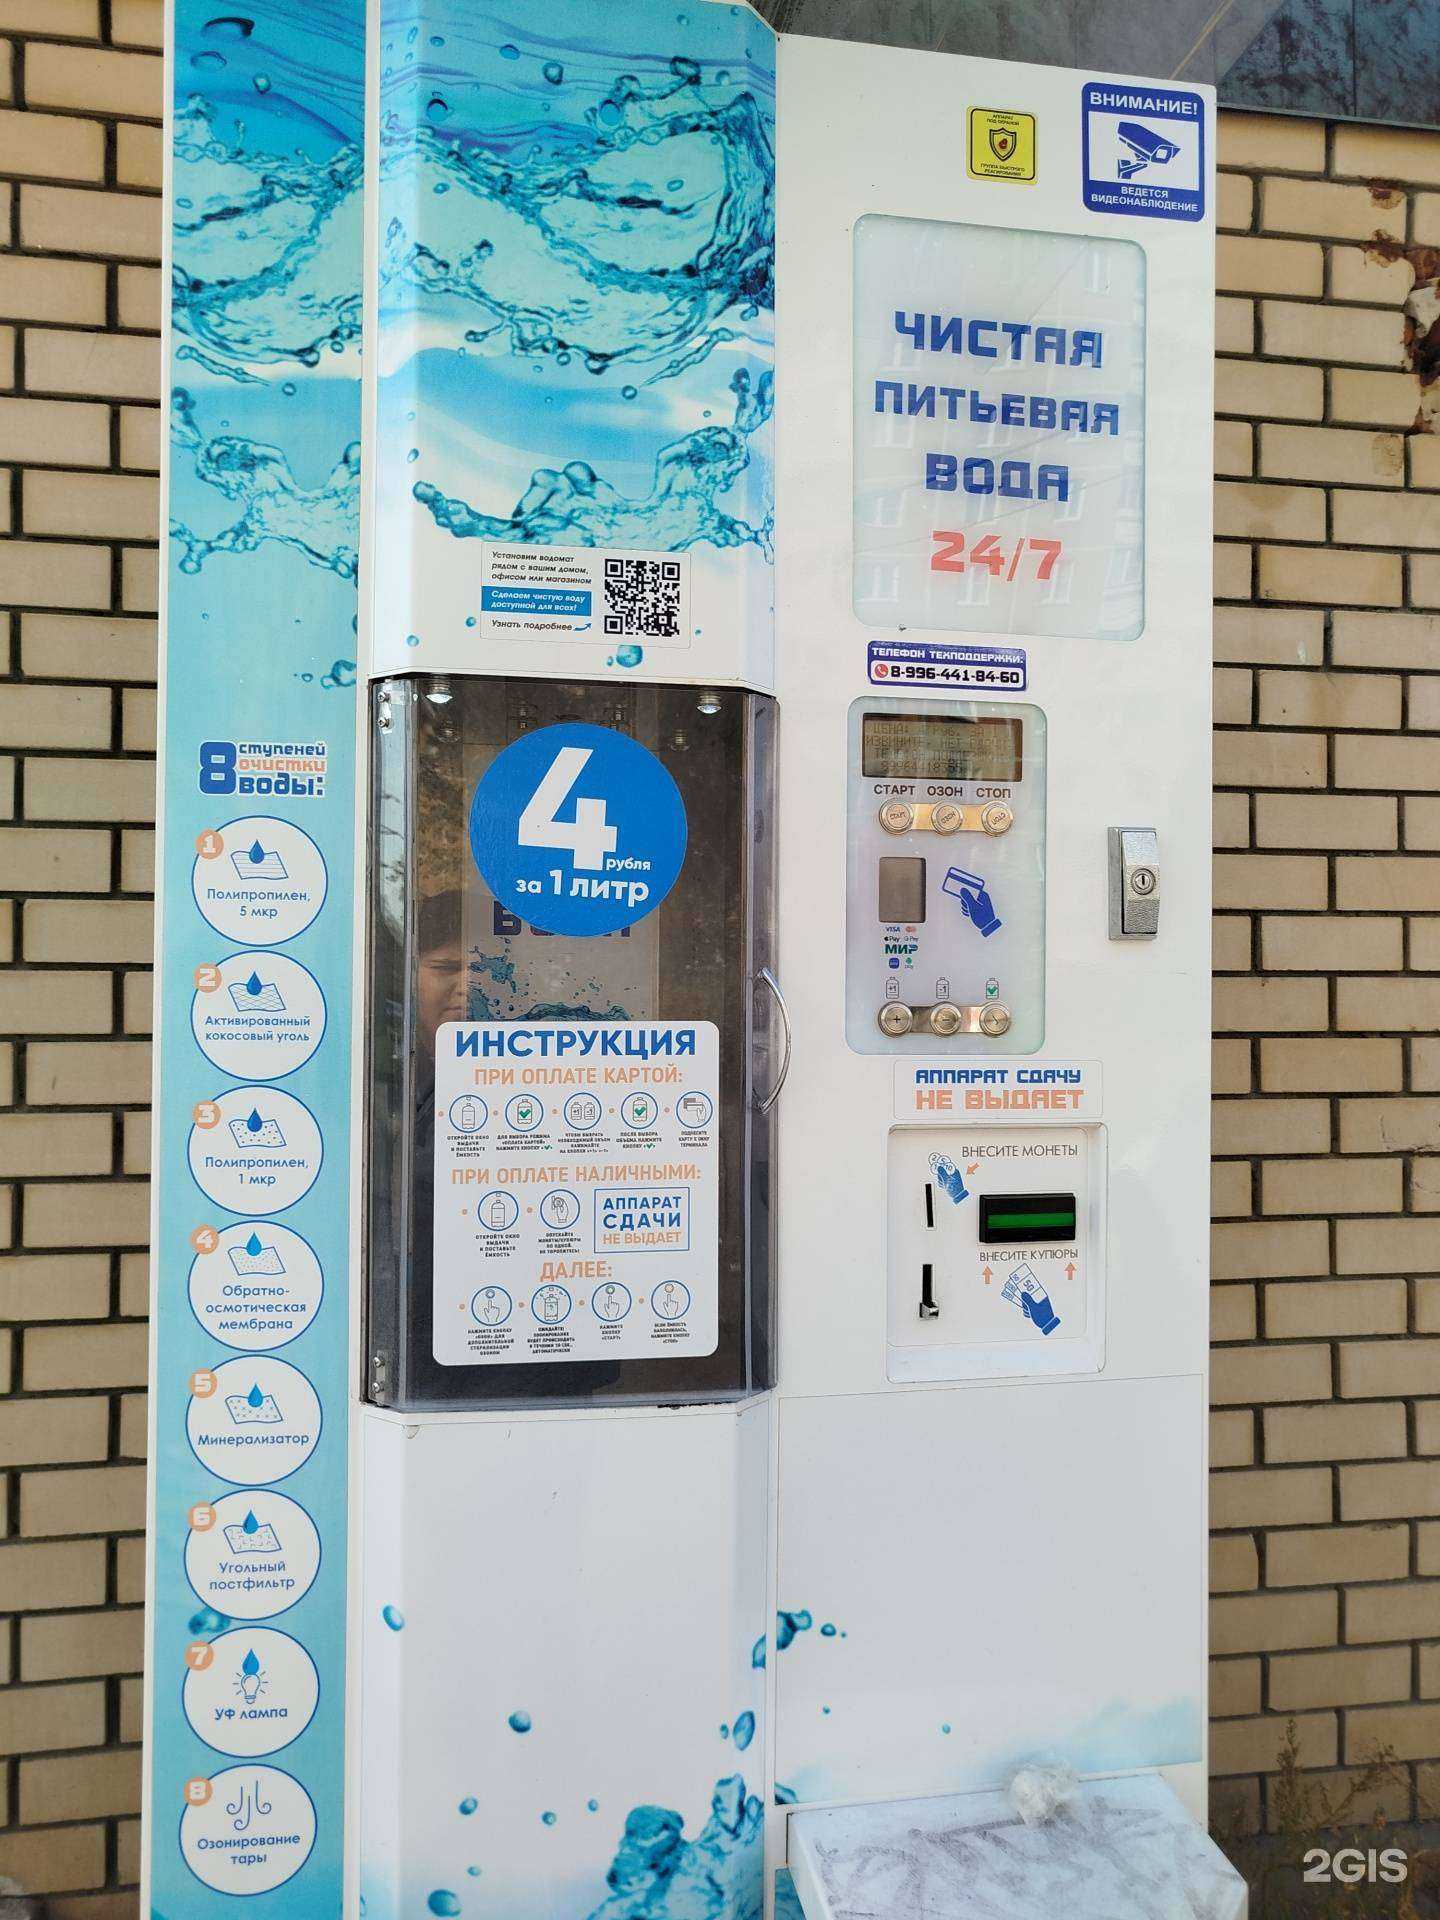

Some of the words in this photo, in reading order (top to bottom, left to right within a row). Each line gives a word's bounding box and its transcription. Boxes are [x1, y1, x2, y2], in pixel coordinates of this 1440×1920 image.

[1090, 92, 1198, 114] ВНИМАНИЕ!
[1121, 187, 1168, 198] ВЕДЕТСЯ
[1091, 194, 1198, 212] ВИДЕОНАБЛЮДЕНИЕ
[895, 310, 1102, 368] ЧИСТАЯ
[875, 380, 1119, 435] ПИТЬЕВАЯ
[926, 453, 1068, 502] ВОДА
[493, 552, 537, 560] Установим
[931, 530, 1062, 581] 24/7
[492, 573, 526, 581] офисом
[492, 591, 530, 599] Сделаем
[524, 622, 572, 630] подробнее
[872, 648, 925, 658] ТЕЛЕФОН
[930, 651, 1024, 663] ТЕХПОДДЕРЖКИ:
[891, 666, 1020, 683] 8-996-441-84-60
[200, 742, 236, 794] 8
[239, 743, 325, 757] ступеней
[239, 759, 325, 772] очистки
[239, 773, 323, 796] воды:
[874, 784, 915, 795] СТАРТ
[927, 785, 963, 796] ОЗОН
[976, 787, 1011, 798] СТОП
[518, 747, 617, 870] 4
[606, 857, 650, 871] рубля
[204, 835, 216, 853] 1
[207, 888, 310, 902] Полипропилен,
[516, 879, 541, 893] за
[550, 870, 562, 894] 1
[570, 878, 649, 907] литр
[240, 906, 246, 916] 5
[251, 908, 278, 919] мкр
[885, 944, 918, 954] МИР
[199, 968, 216, 987] 2
[205, 1015, 310, 1027] Активированный
[206, 1031, 273, 1041] кокосовый
[277, 1033, 309, 1043] уголь
[457, 1030, 696, 1060] ИНСТРУКЦИЯ
[475, 1069, 514, 1084] ПРИ
[522, 1067, 596, 1084] ОПЛАТЕ
[605, 1064, 682, 1083] КАРТОЙ:
[916, 1069, 1008, 1084] АППАРАТ
[1017, 1069, 1081, 1084] СДАЧУ
[916, 1089, 952, 1110] НЕ
[965, 1089, 1083, 1109] ВЫДАЕТ
[199, 1105, 215, 1123] 3
[962, 1146, 1020, 1158] ВНЕСИТЕ
[1022, 1145, 1078, 1157] МОНЕТЫ
[205, 1157, 308, 1170] Полипропилен,
[239, 1174, 243, 1184] 1
[249, 1175, 276, 1186] мкр
[452, 1168, 490, 1184] ПРИ
[497, 1167, 568, 1183] ОПЛАТЕ
[576, 1164, 700, 1181] НАЛИЧНЫМИ:
[603, 1197, 682, 1210] АППАРАТ
[603, 1213, 681, 1230] СДАЧИ
[196, 1230, 213, 1248] 4
[603, 1233, 620, 1244] НЕ
[624, 1232, 682, 1244] ВЫДАЕТ
[979, 1251, 1028, 1262] ВНЕСИТЕ
[1030, 1249, 1078, 1261] КУПЮРЫ
[540, 1261, 612, 1282] ДАЛЕЕ:
[222, 1286, 290, 1298] Обратно-
[1024, 1280, 1034, 1291] 50
[206, 1303, 306, 1313] осмотическая
[219, 1319, 292, 1331] мембрана
[194, 1374, 212, 1392] 5
[198, 1434, 309, 1448] Минерализатор
[193, 1508, 211, 1525] 6
[219, 1561, 285, 1574] Угольный
[209, 1578, 295, 1591] постфильтр
[191, 1647, 208, 1664] 7
[215, 1708, 236, 1720] УФ
[240, 1708, 288, 1719] лампа
[198, 1834, 300, 1849] Озонирование
[231, 1854, 266, 1865] тары
